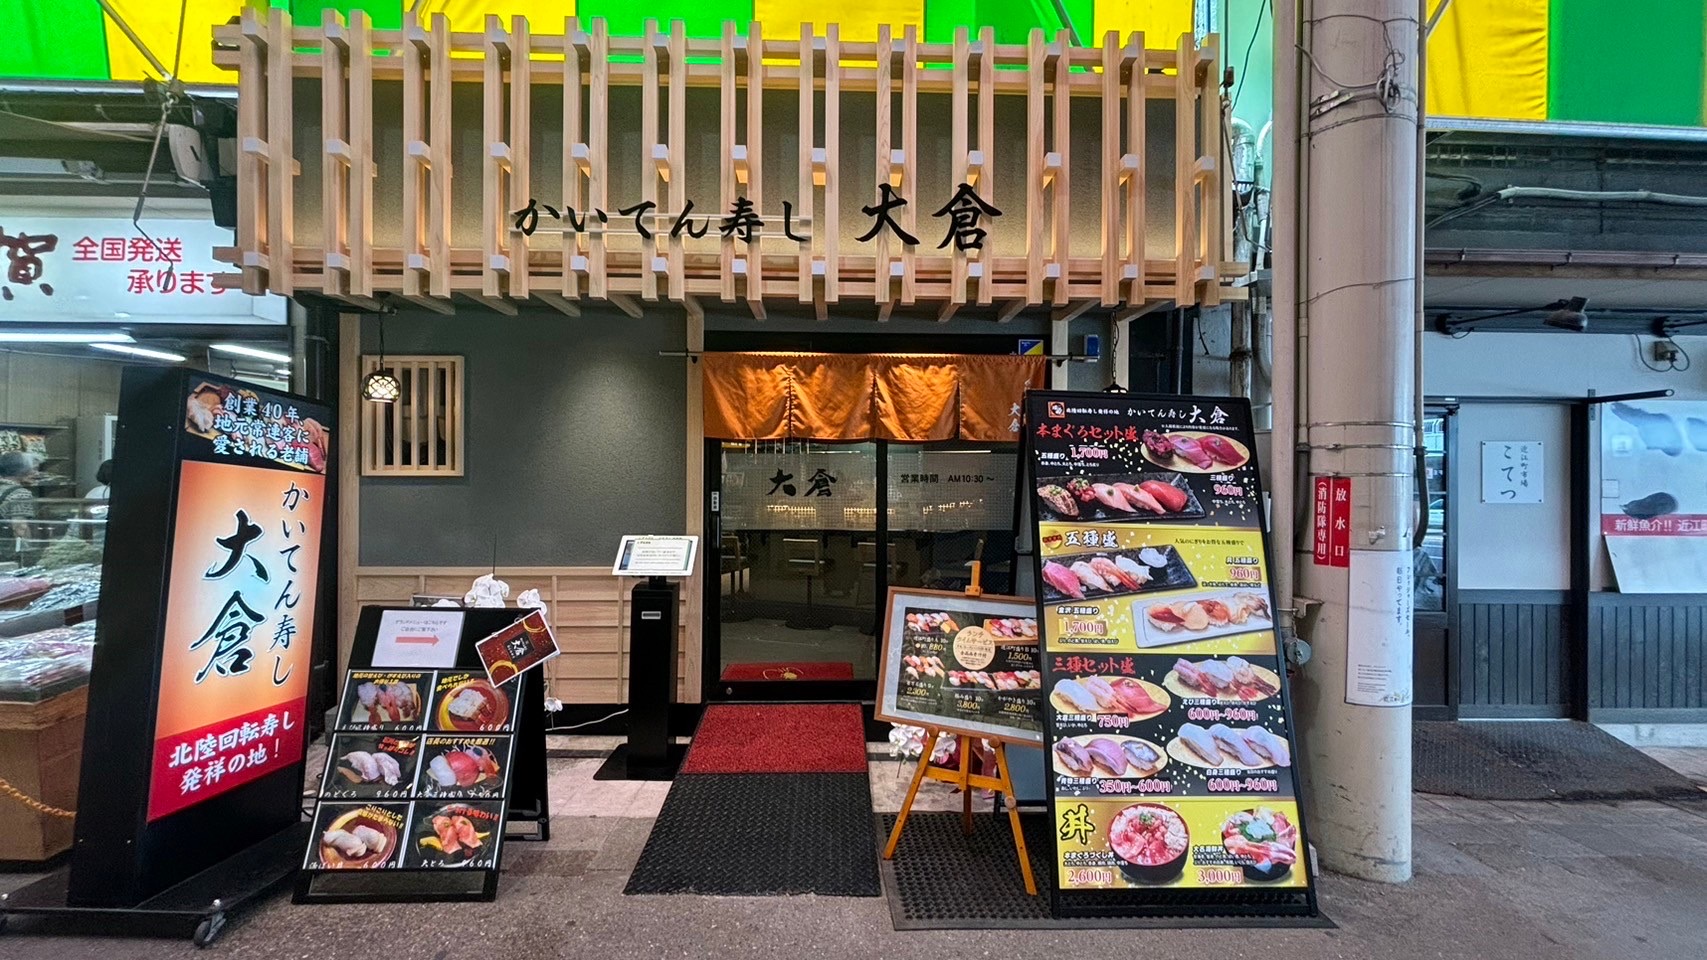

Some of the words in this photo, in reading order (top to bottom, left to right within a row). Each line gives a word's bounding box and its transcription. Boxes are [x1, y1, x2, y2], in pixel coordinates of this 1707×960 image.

[514, 196, 808, 244] かいてん寿し
[854, 182, 1004, 252] 大倉
[72, 236, 183, 263] 全国発送
[1189, 404, 1230, 425] 大倉
[213, 413, 311, 444] 地元常連客に
[1035, 422, 1139, 442] 本まぐろセット盛
[212, 434, 309, 465] 愛される老舗
[1070, 446, 1109, 460] 1,700円
[1500, 445, 1517, 500] こてつ
[1520, 445, 1529, 488] 近江町市場
[766, 467, 838, 498] 大倉
[900, 473, 940, 485] 営業時間
[1213, 483, 1244, 497] 960円
[1335, 487, 1347, 557] 放水口
[1064, 529, 1120, 549] 五種盛
[270, 481, 310, 687] かいてん寿し
[1230, 567, 1259, 580] 960円
[188, 508, 271, 684] 大倉
[1064, 620, 1105, 636] 1,700円
[1052, 656, 1136, 674] 三種セット盛
[1096, 714, 1130, 729] 750円
[168, 709, 296, 769] 北陸回転寿し
[376, 790, 408, 798] 960円
[1060, 803, 1096, 846] 丼
[1068, 869, 1113, 884] 2,600円
[1198, 868, 1242, 884] 3,000円
